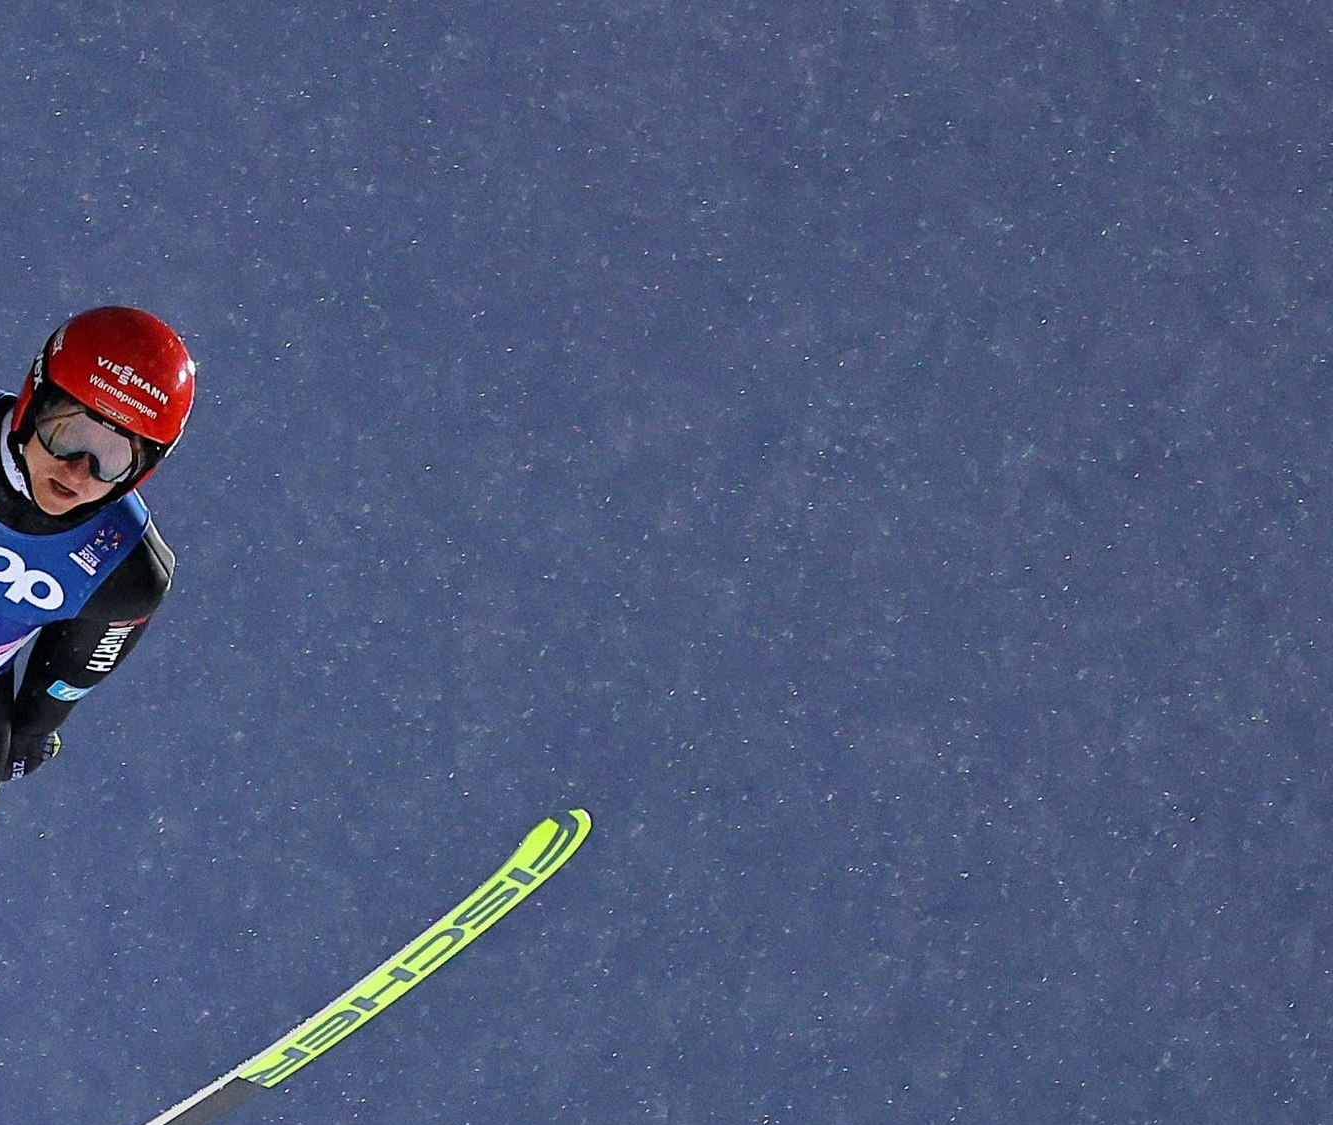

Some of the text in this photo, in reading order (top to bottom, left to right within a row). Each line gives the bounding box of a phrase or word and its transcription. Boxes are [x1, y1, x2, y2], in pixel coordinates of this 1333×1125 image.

[89, 373, 158, 420] Wärmepumpen
[96, 356, 169, 405] VIESSMANN
[86, 626, 135, 672] WÜRTH
[246, 811, 579, 1084] FISCHER
